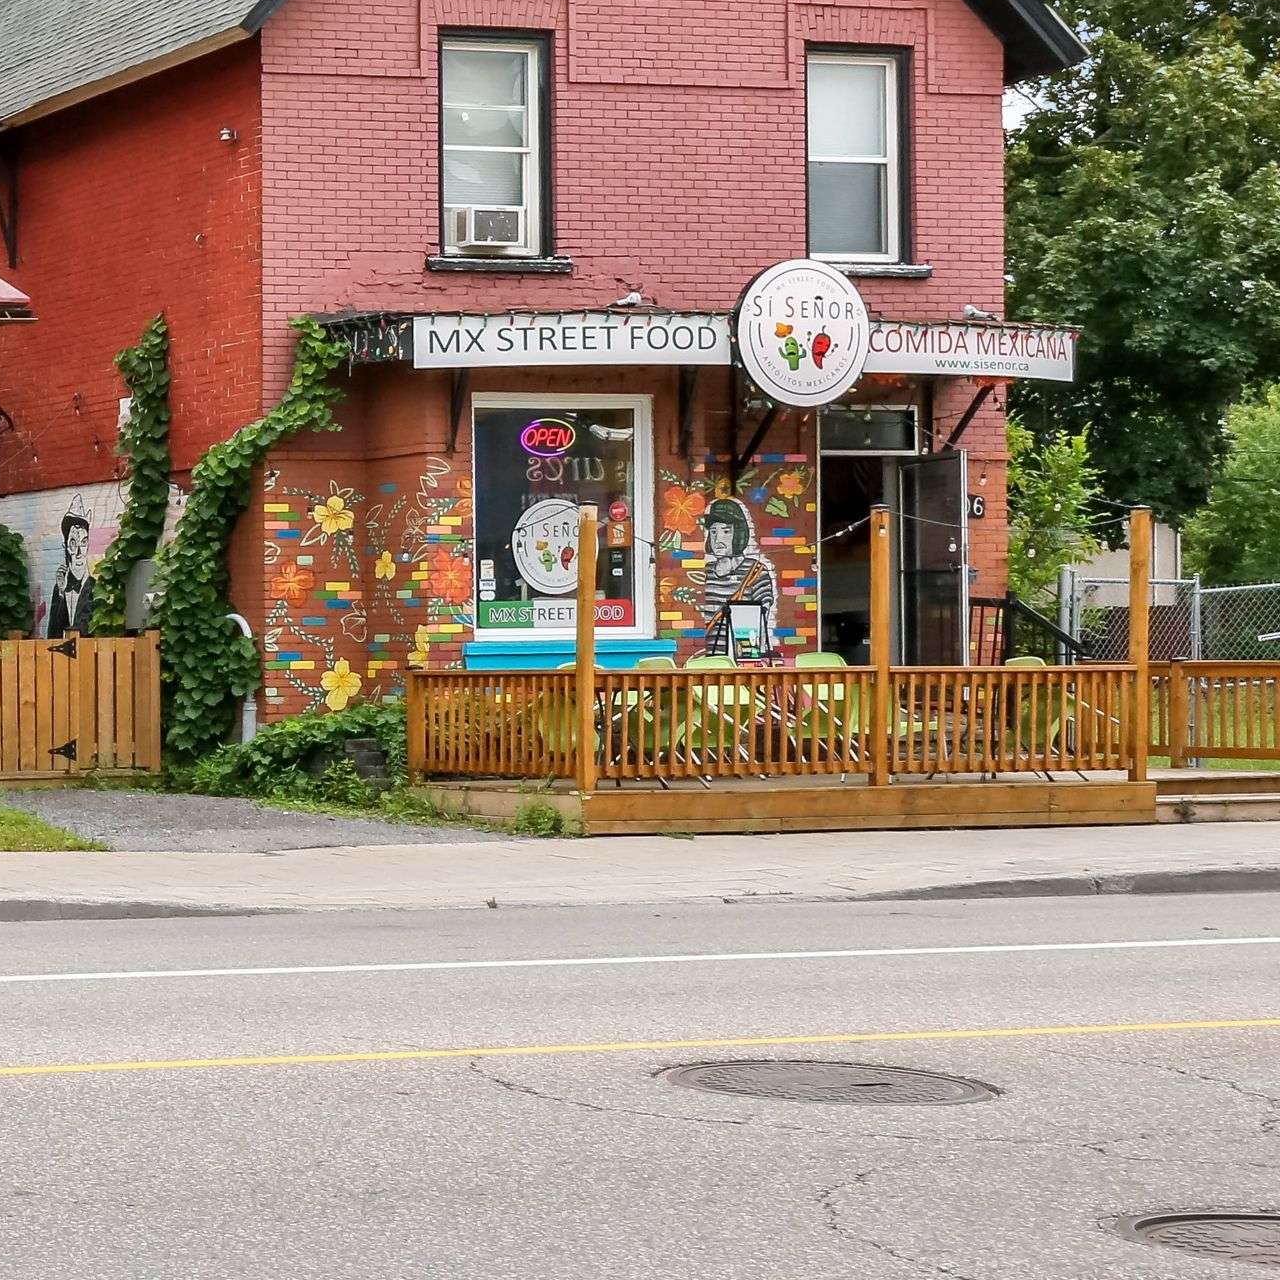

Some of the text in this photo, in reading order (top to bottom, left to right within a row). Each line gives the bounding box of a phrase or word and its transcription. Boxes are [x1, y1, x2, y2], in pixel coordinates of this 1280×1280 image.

[428, 325, 717, 353] MX STREET FOOD
[869, 329, 1067, 361] COMIDA MEXICANA
[763, 356, 802, 387] ANTOJITOS
[935, 358, 1030, 371] www.sisenor.ca
[524, 428, 570, 446] OPEN
[490, 607, 516, 622] MX
[519, 606, 575, 622] STREET
